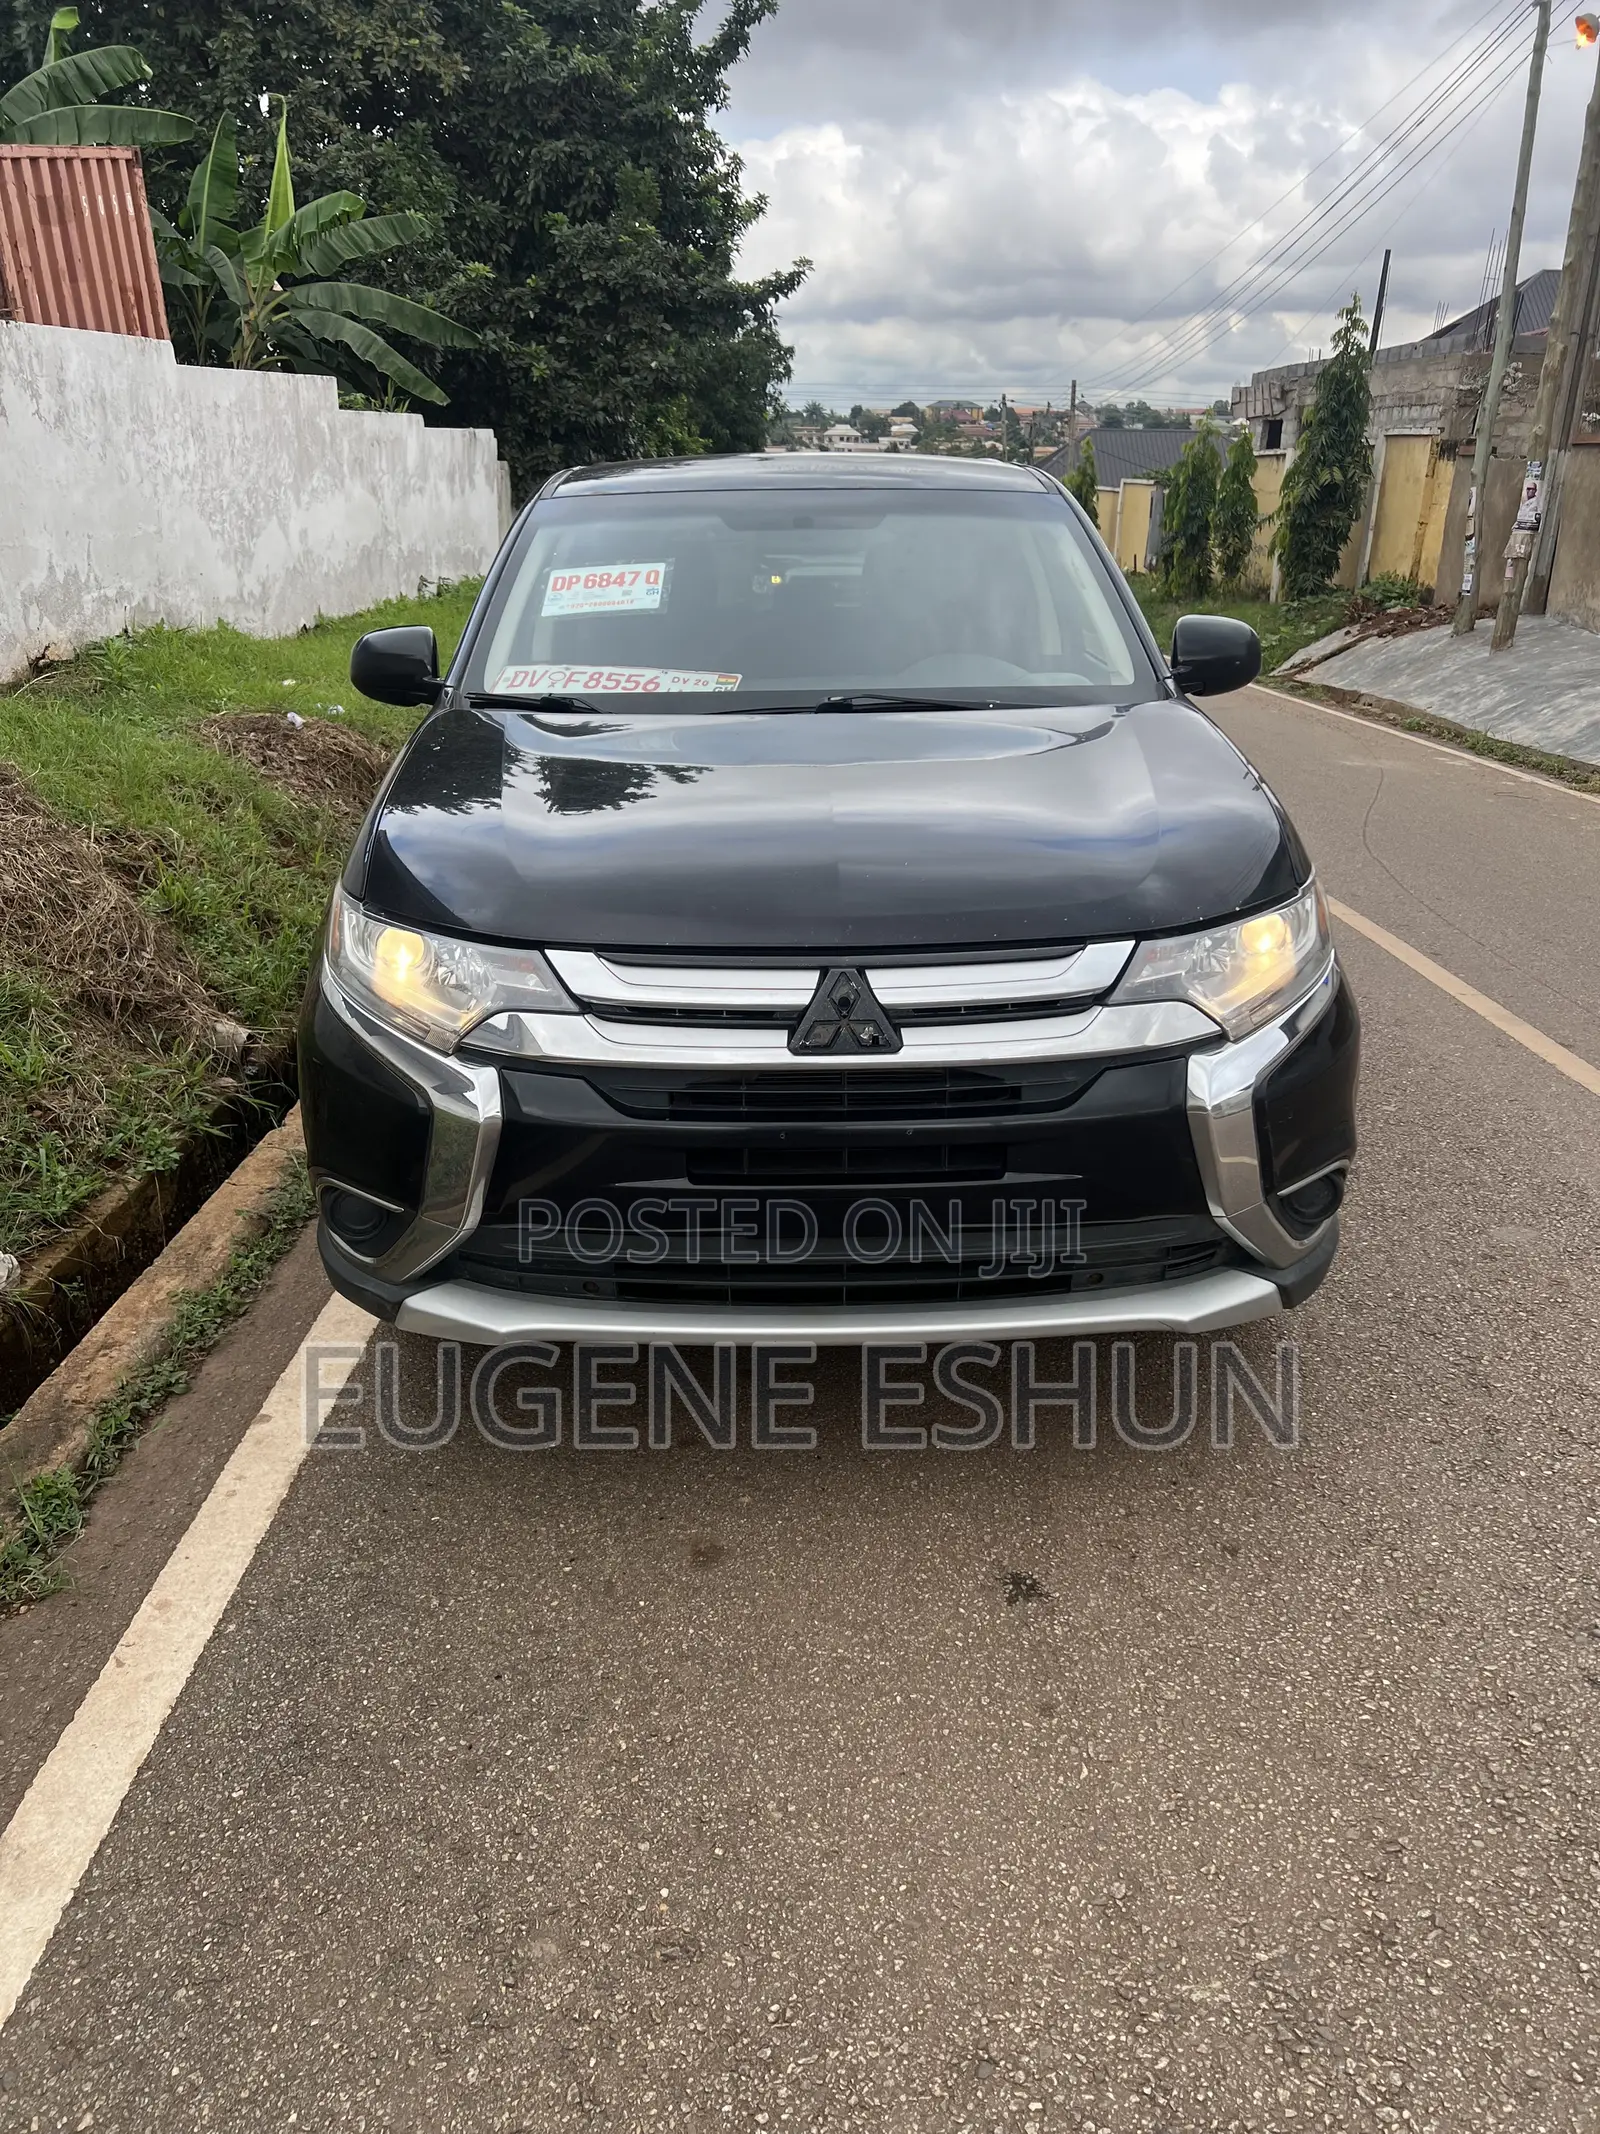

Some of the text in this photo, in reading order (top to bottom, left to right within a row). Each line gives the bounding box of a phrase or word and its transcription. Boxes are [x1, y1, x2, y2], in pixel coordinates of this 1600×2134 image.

[552, 575, 581, 592] DP
[583, 571, 641, 589] 6847
[506, 670, 661, 692] DV F8556
[671, 676, 710, 687] DV 20
